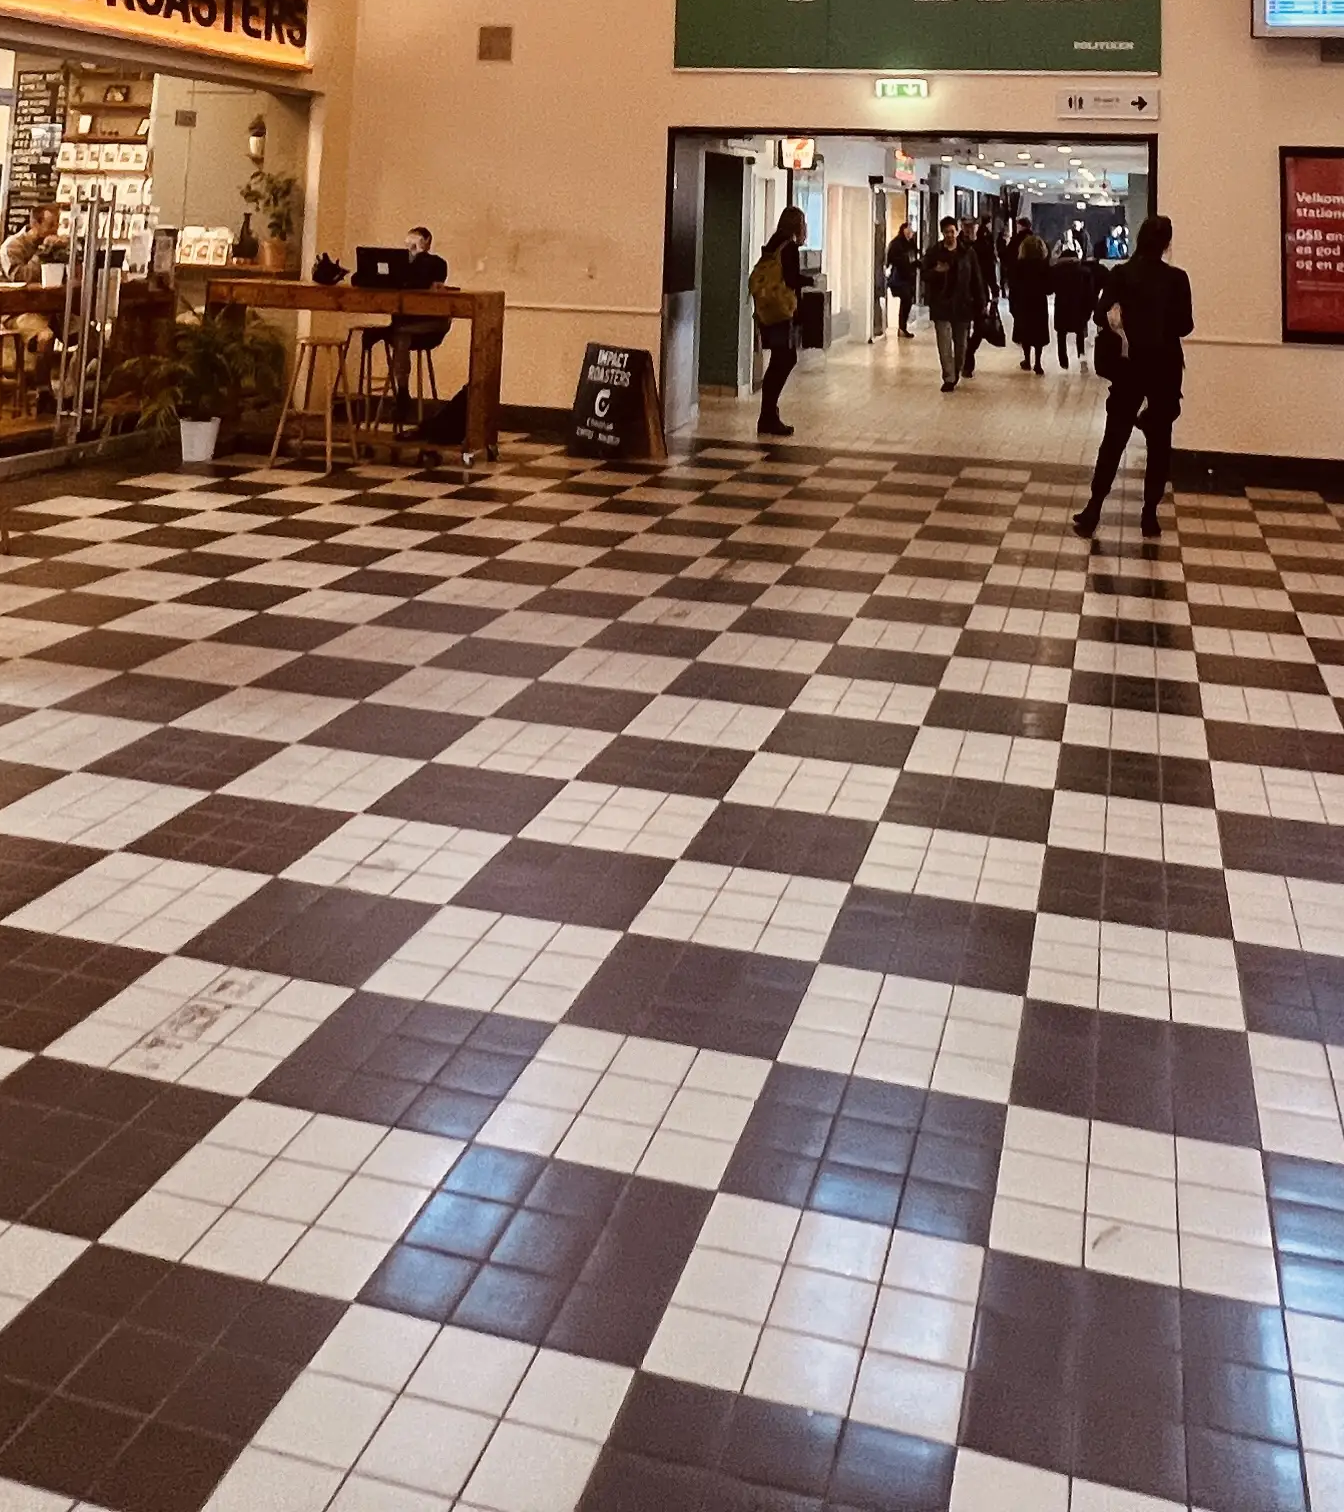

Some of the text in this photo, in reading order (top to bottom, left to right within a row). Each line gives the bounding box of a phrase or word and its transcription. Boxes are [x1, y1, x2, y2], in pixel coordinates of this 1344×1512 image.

[1296, 228, 1323, 241] DSB
[1296, 245, 1312, 254] en
[1316, 245, 1340, 257] god
[1296, 260, 1312, 271] og
[1316, 260, 1332, 270] en
[597, 349, 629, 368] IMPACT
[587, 365, 632, 387] ROASTERS
